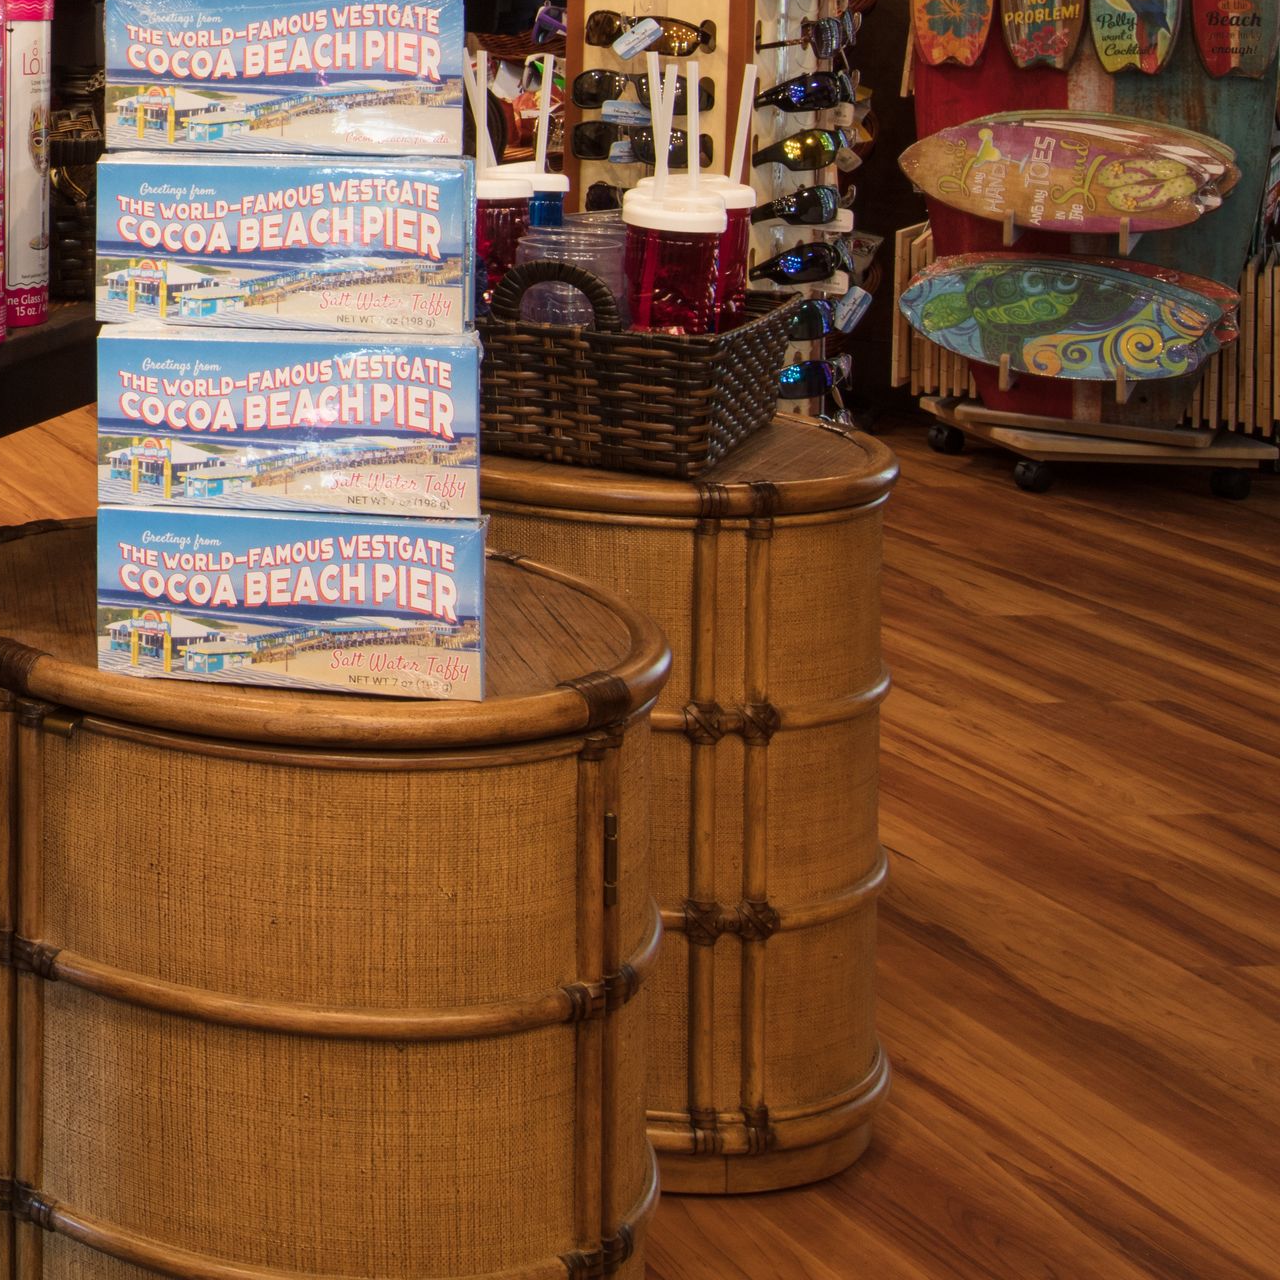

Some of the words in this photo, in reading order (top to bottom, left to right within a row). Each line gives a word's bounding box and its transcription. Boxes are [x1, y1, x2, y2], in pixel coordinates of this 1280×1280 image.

[126, 24, 164, 46] THE
[166, 9, 328, 48] WORLD-FAMOUS
[332, 3, 440, 36] WESTGATE
[1004, 3, 1080, 27] PROBLEM!
[1096, 12, 1137, 31] Polly
[1205, 11, 1262, 27] Beach
[126, 43, 238, 80] COCOA
[243, 29, 357, 78] BEACH
[362, 29, 441, 83] PIER
[1024, 136, 1057, 188] TOES
[116, 194, 156, 219] THE
[159, 183, 324, 221] WORLD-FAMOUS
[329, 178, 440, 211] WESTGATE
[140, 182, 187, 199] Greetings
[189, 184, 217, 201] from
[116, 215, 232, 254] COCOA
[237, 206, 355, 253] BEACH
[360, 205, 441, 261] PIER
[15, 307, 26, 317] 15
[21, 294, 41, 306] Glass
[319, 291, 352, 311] Salt
[411, 291, 453, 317] Taffy
[118, 370, 157, 394] THE
[162, 359, 332, 398] WORLD-FAMOUS
[336, 354, 452, 390] WESTGATE
[142, 357, 192, 376] Greetings
[193, 359, 222, 377] from
[118, 391, 238, 432] COCOA
[243, 383, 365, 432] BEACH
[370, 383, 455, 440] PIER
[329, 471, 365, 490] Salt
[368, 472, 418, 492] Water
[425, 473, 467, 498] Taffy
[347, 495, 368, 505] NET
[118, 542, 159, 567] THE
[162, 537, 334, 572] WORLD-FAMOUS
[337, 534, 456, 572] WESTGATE
[142, 530, 192, 549] Greetings
[193, 532, 222, 551] from
[118, 563, 238, 607] COCOA
[244, 563, 367, 608] BEACH
[372, 563, 458, 623] PIER
[330, 649, 365, 670] Salt
[369, 652, 420, 673] Water
[427, 655, 470, 682] Taffy
[372, 676, 390, 685] WT
[392, 677, 398, 687] 7
